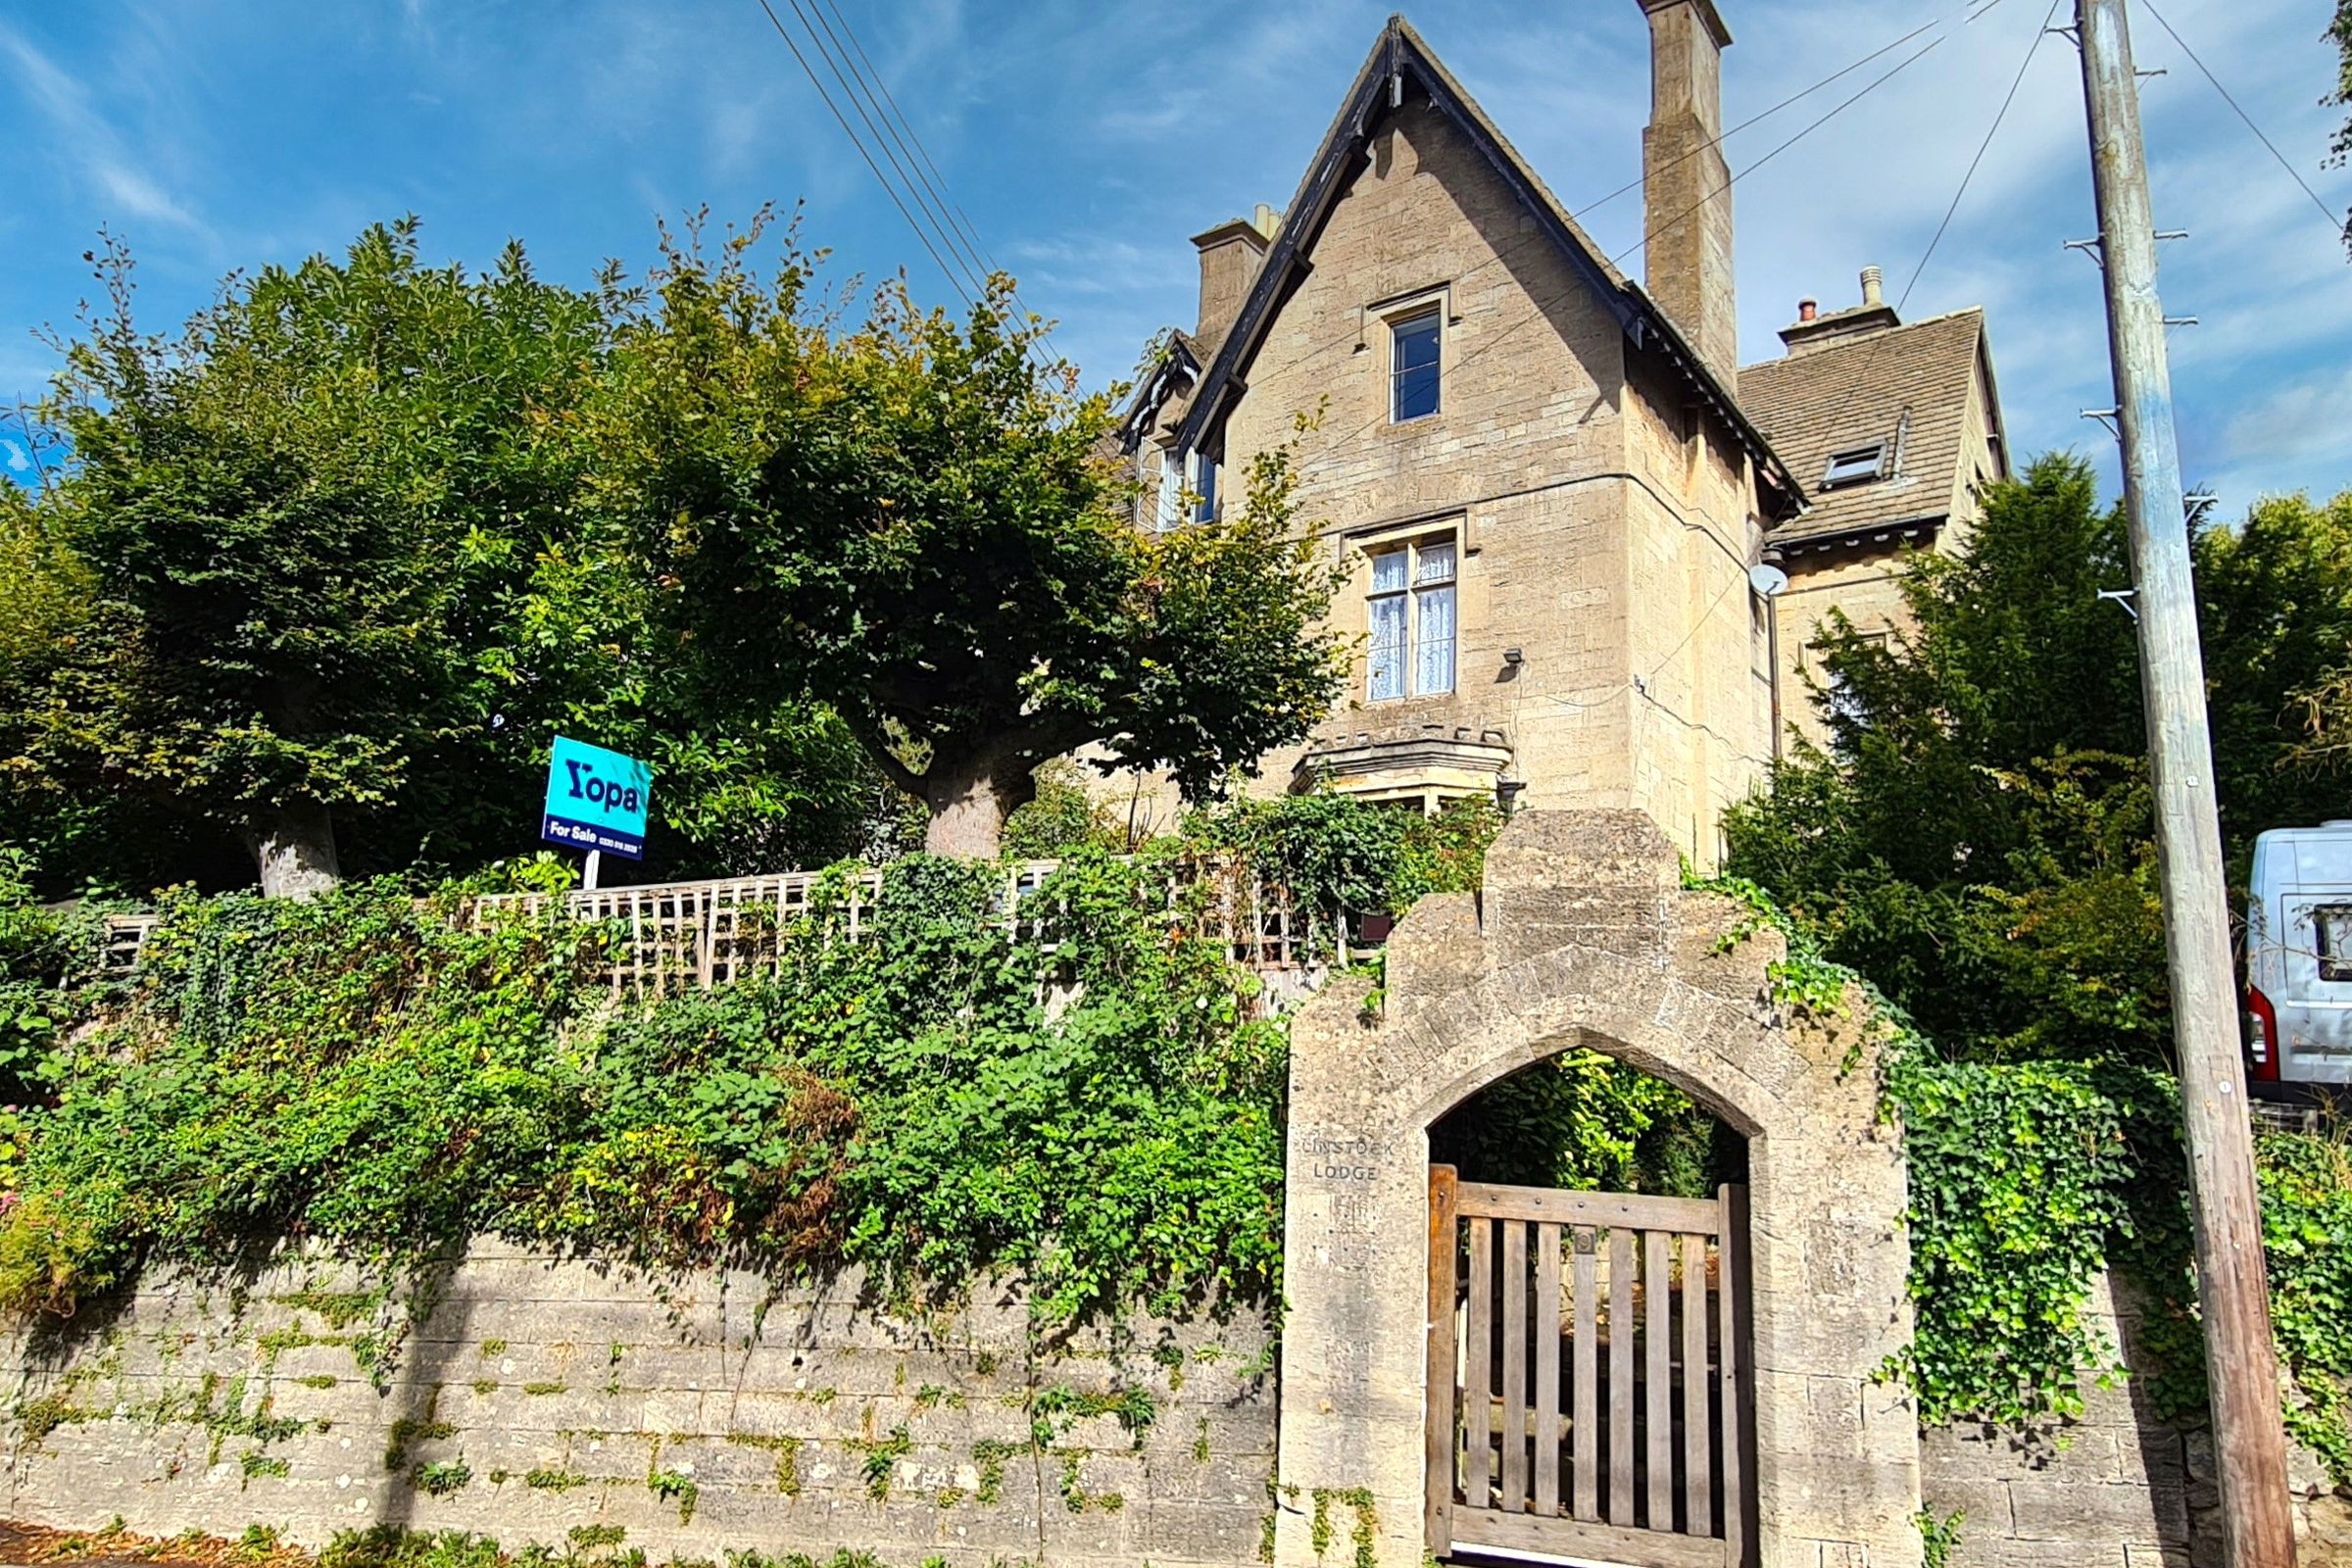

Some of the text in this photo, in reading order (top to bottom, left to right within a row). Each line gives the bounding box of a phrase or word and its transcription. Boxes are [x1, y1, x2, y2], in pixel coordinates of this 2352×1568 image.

[565, 759, 638, 813] Yopa
[550, 821, 597, 843] For Sale
[1314, 1163, 1378, 1181] LODGE
